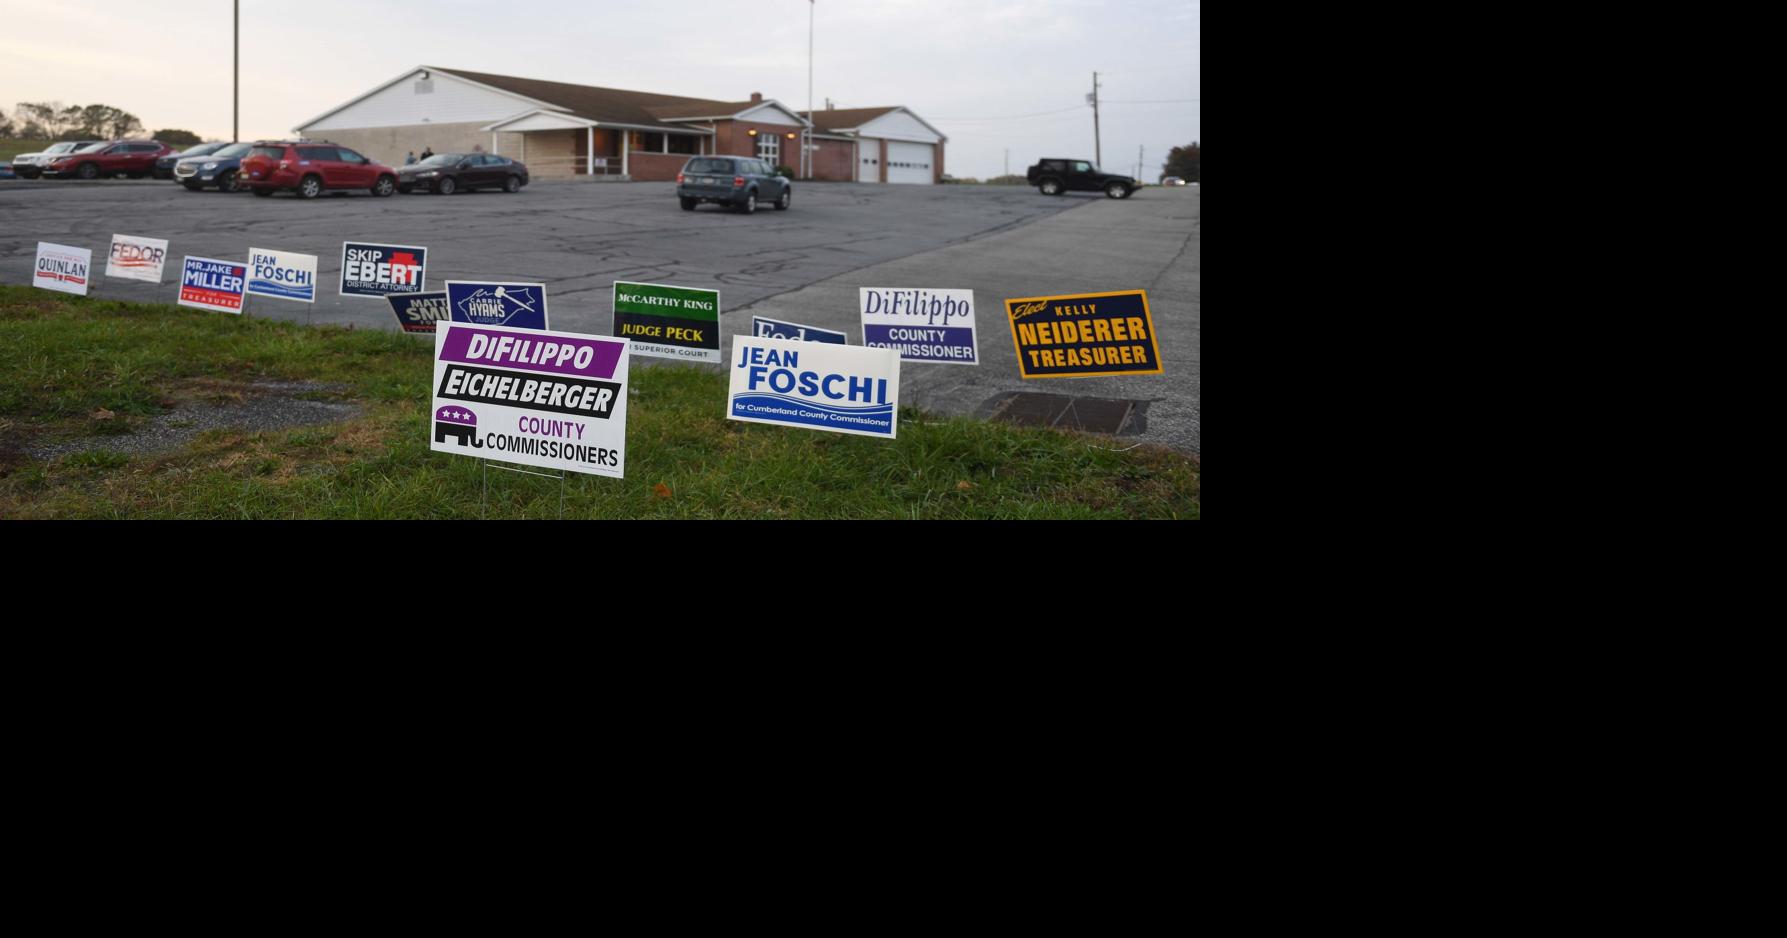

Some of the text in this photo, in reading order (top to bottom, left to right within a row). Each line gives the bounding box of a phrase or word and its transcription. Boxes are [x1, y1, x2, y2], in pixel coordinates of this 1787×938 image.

[111, 242, 164, 263] FEDOR
[252, 254, 276, 266] JEAN
[347, 249, 382, 262] SKIP
[38, 257, 86, 277] QUINLAN
[255, 264, 312, 285] FOSCHI
[345, 260, 422, 286] EBERT
[184, 270, 243, 293] MILLER
[347, 280, 379, 289] DISTRICT
[380, 283, 419, 292] ATTORNEY
[183, 293, 240, 307] TREASURER
[410, 298, 447, 308] MATT
[469, 302, 505, 318] HYAMS
[618, 293, 713, 311] McCARTHY KING
[864, 290, 970, 326] DiFilippo
[1012, 300, 1097, 320] Elect KELLY
[405, 306, 449, 321] SMI
[477, 316, 500, 324] JUDGE
[622, 323, 704, 342] JUDGE PECK
[888, 328, 946, 342] COUNTY
[1018, 316, 1147, 346] NEIDERER
[465, 333, 594, 370] DIFILIPPO
[634, 344, 676, 354] SUPERIOR
[678, 348, 709, 358] COURT
[737, 346, 799, 369] JEAN
[867, 342, 973, 359] MISSIONER
[1028, 345, 1148, 368] TREASURER
[444, 369, 613, 412] EICHELBERGER
[748, 366, 888, 405] FOSCHI
[735, 402, 746, 410] for
[747, 404, 798, 416] Cumberland
[798, 410, 829, 421] County
[829, 413, 890, 427] Commissioner
[518, 415, 586, 440] COUNTY
[486, 432, 618, 467] COMMISSIONERS
